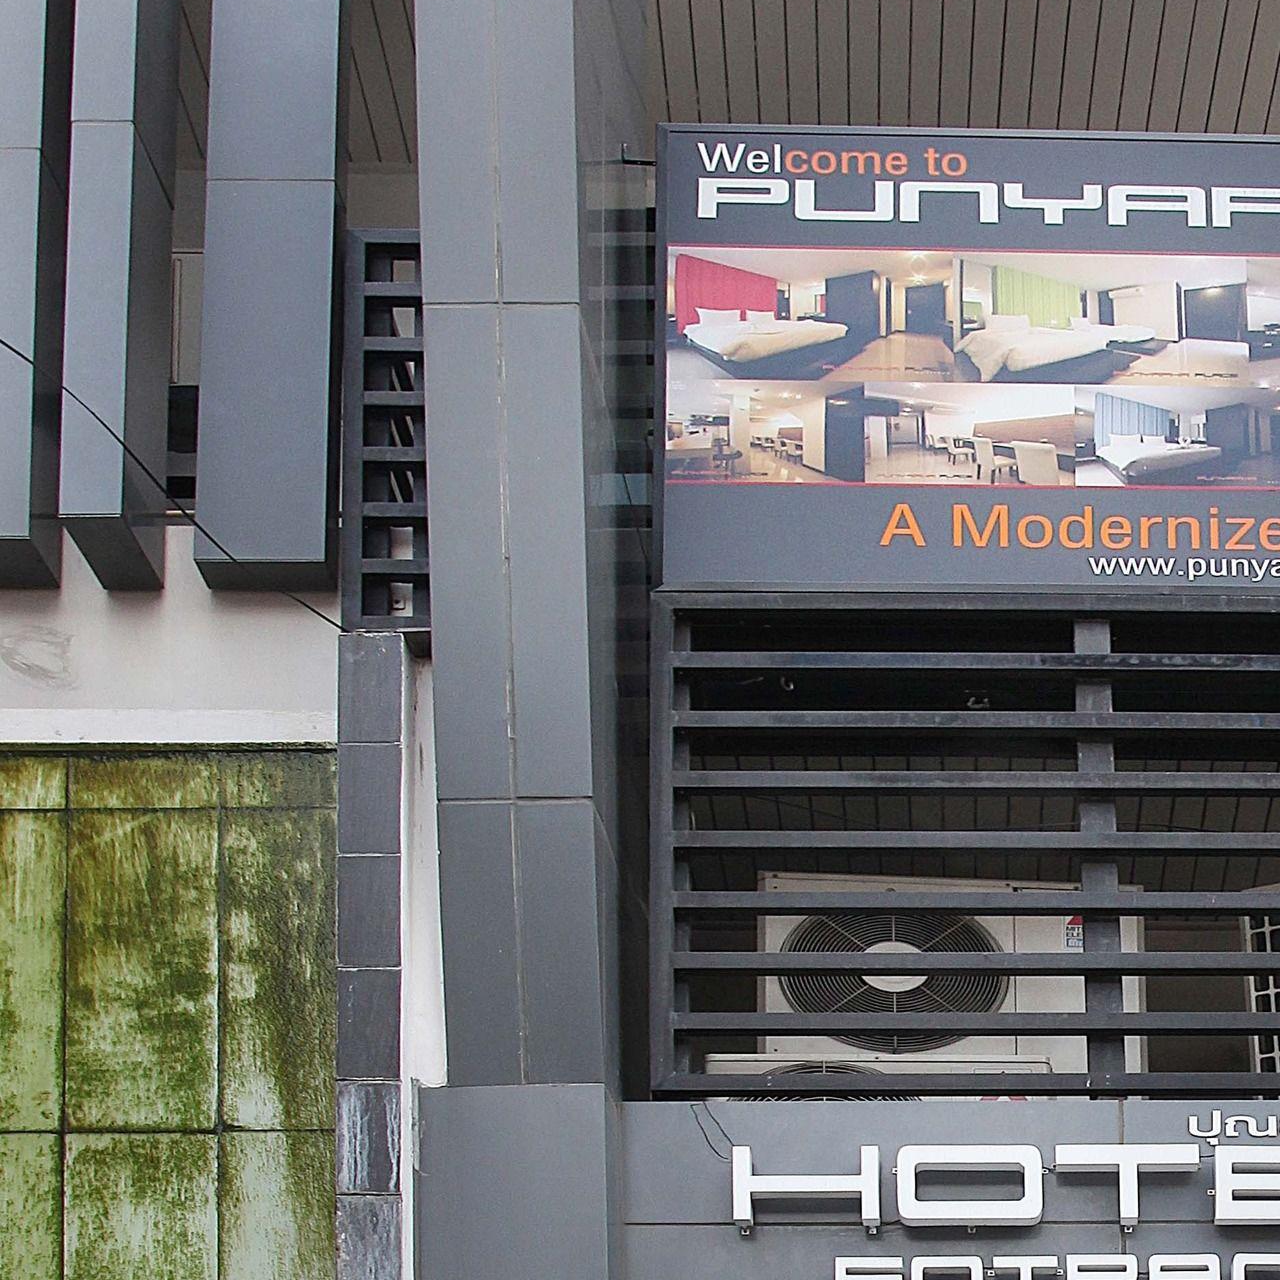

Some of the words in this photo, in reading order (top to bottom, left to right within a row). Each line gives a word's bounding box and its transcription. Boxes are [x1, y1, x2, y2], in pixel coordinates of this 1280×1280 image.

[697, 142, 908, 176] Welcome
[924, 147, 968, 177] to
[879, 503, 927, 548] A
